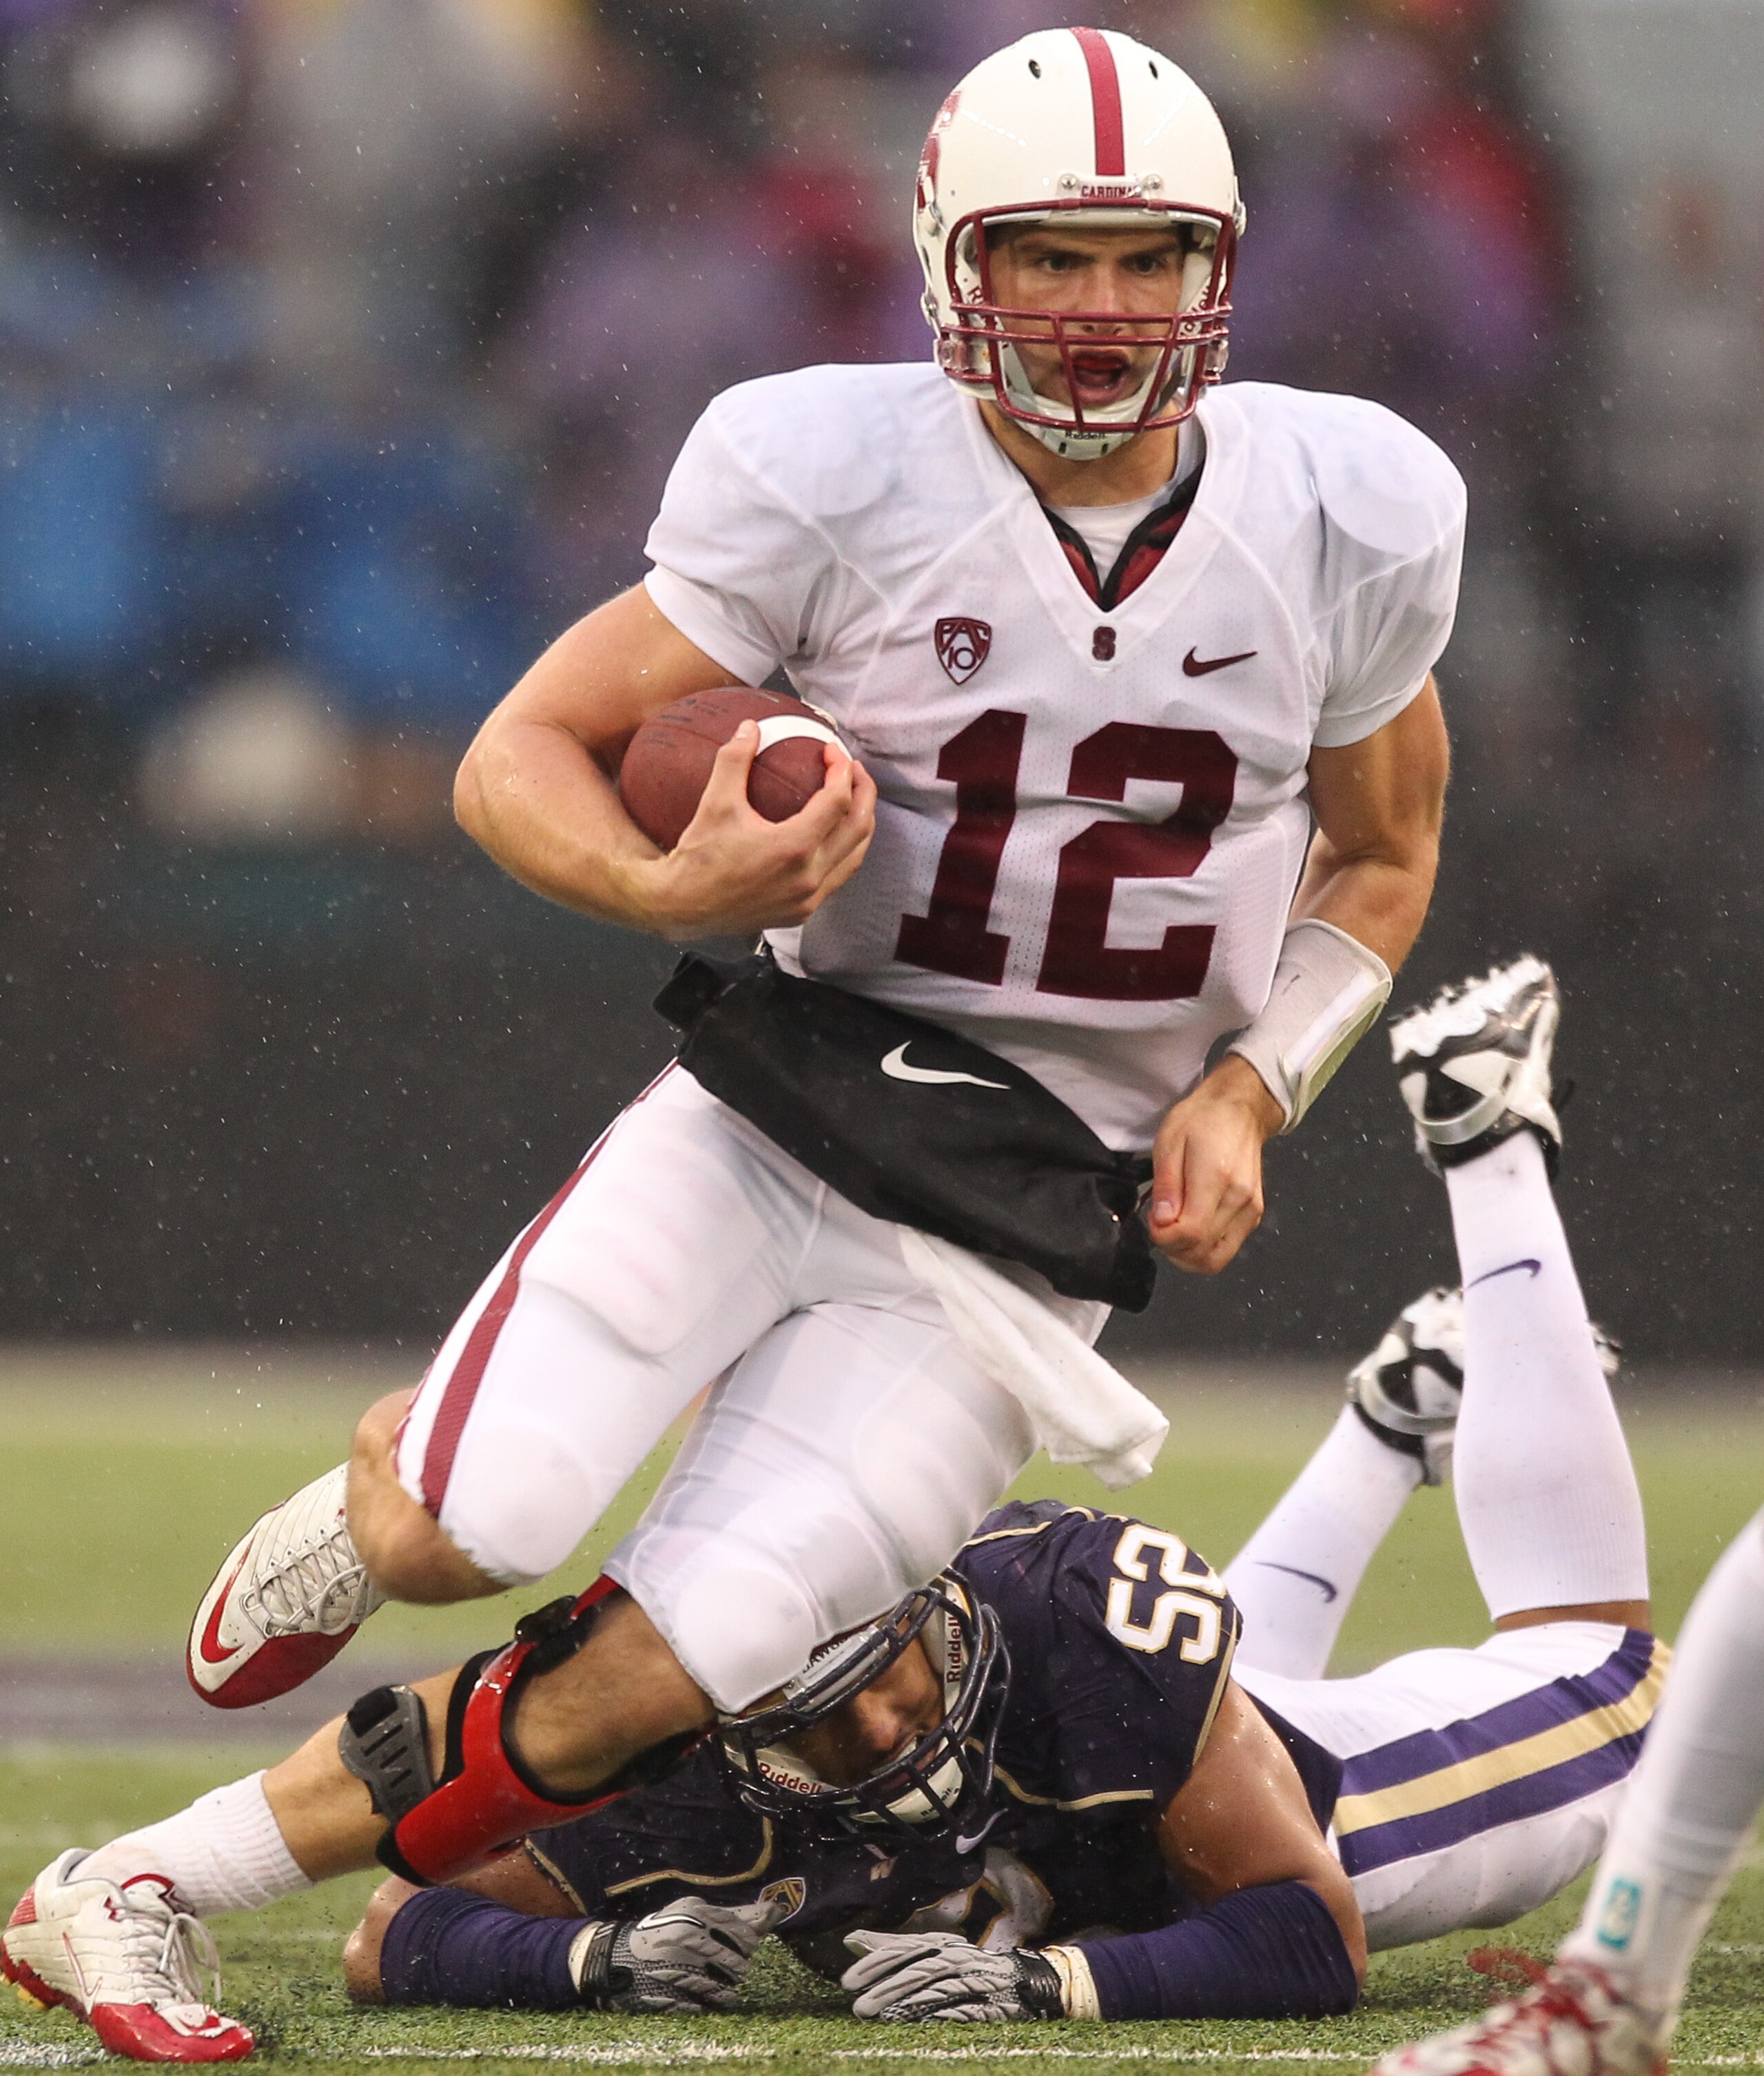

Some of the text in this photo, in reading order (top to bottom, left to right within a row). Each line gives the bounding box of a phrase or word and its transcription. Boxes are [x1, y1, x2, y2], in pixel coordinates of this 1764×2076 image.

[1091, 626, 1116, 661] S
[894, 709, 1238, 1001] 12
[1105, 1523, 1226, 1665] 52
[759, 1762, 823, 1794] Riddell
